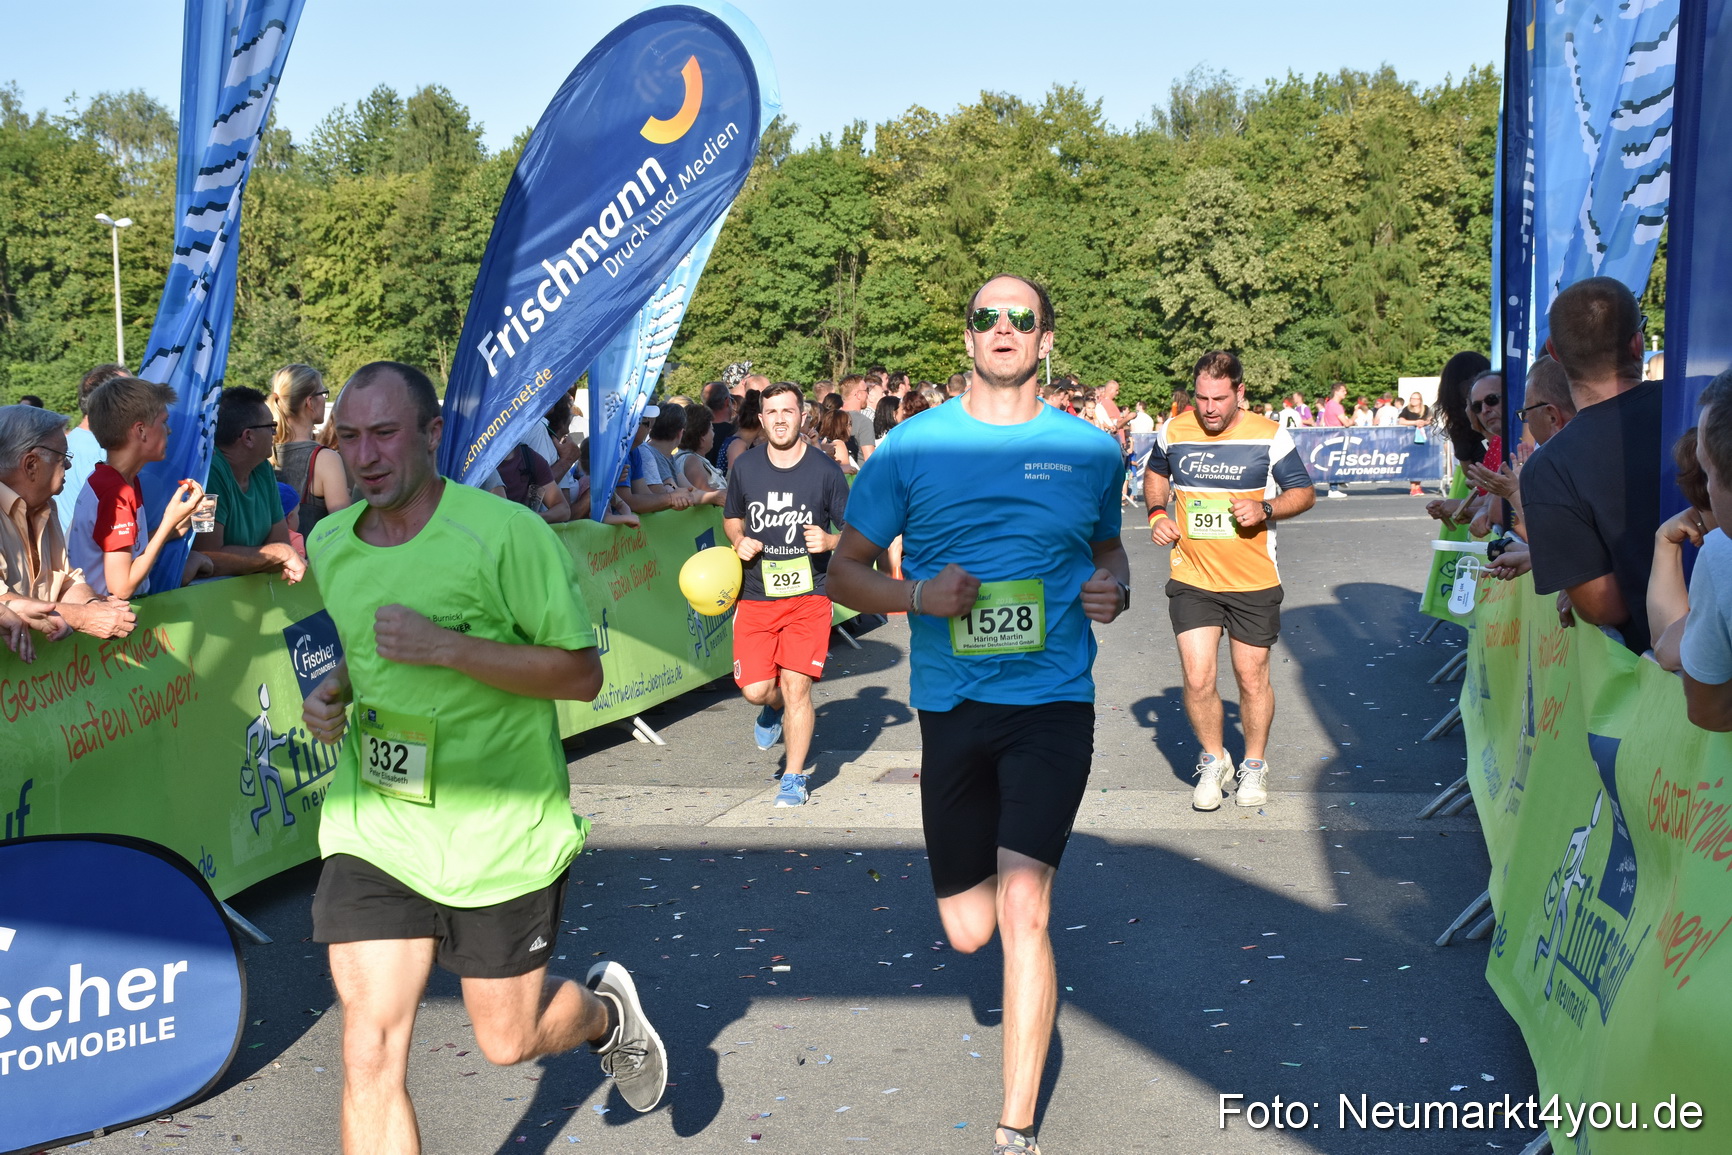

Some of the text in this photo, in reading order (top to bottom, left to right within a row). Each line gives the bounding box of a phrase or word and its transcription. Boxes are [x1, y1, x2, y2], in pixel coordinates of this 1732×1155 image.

[602, 121, 740, 279] Druck und Medien
[477, 157, 667, 377] Frischmann
[1032, 462, 1073, 473] PFLEIDERER
[1327, 449, 1410, 467] Fischer
[1024, 472, 1050, 480] Martin
[1189, 461, 1247, 475] Fischer
[1193, 473, 1242, 481] AUTOMOBILE
[1334, 466, 1403, 476] AUTOMOBILE
[747, 501, 813, 544] Burgis
[1194, 513, 1222, 528] 591
[772, 571, 801, 588] 292
[960, 605, 1034, 636] 1528
[973, 633, 1024, 643] Häring Martin
[302, 643, 335, 672] Fischer
[0, 627, 176, 723] Gesunde Firmen
[310, 659, 337, 680] AUTOMOBILE
[60, 654, 199, 762] laufen länger!
[369, 737, 409, 775] 332
[369, 767, 408, 785] Peter Elisabeth
[1554, 978, 1591, 1031] neumarkt
